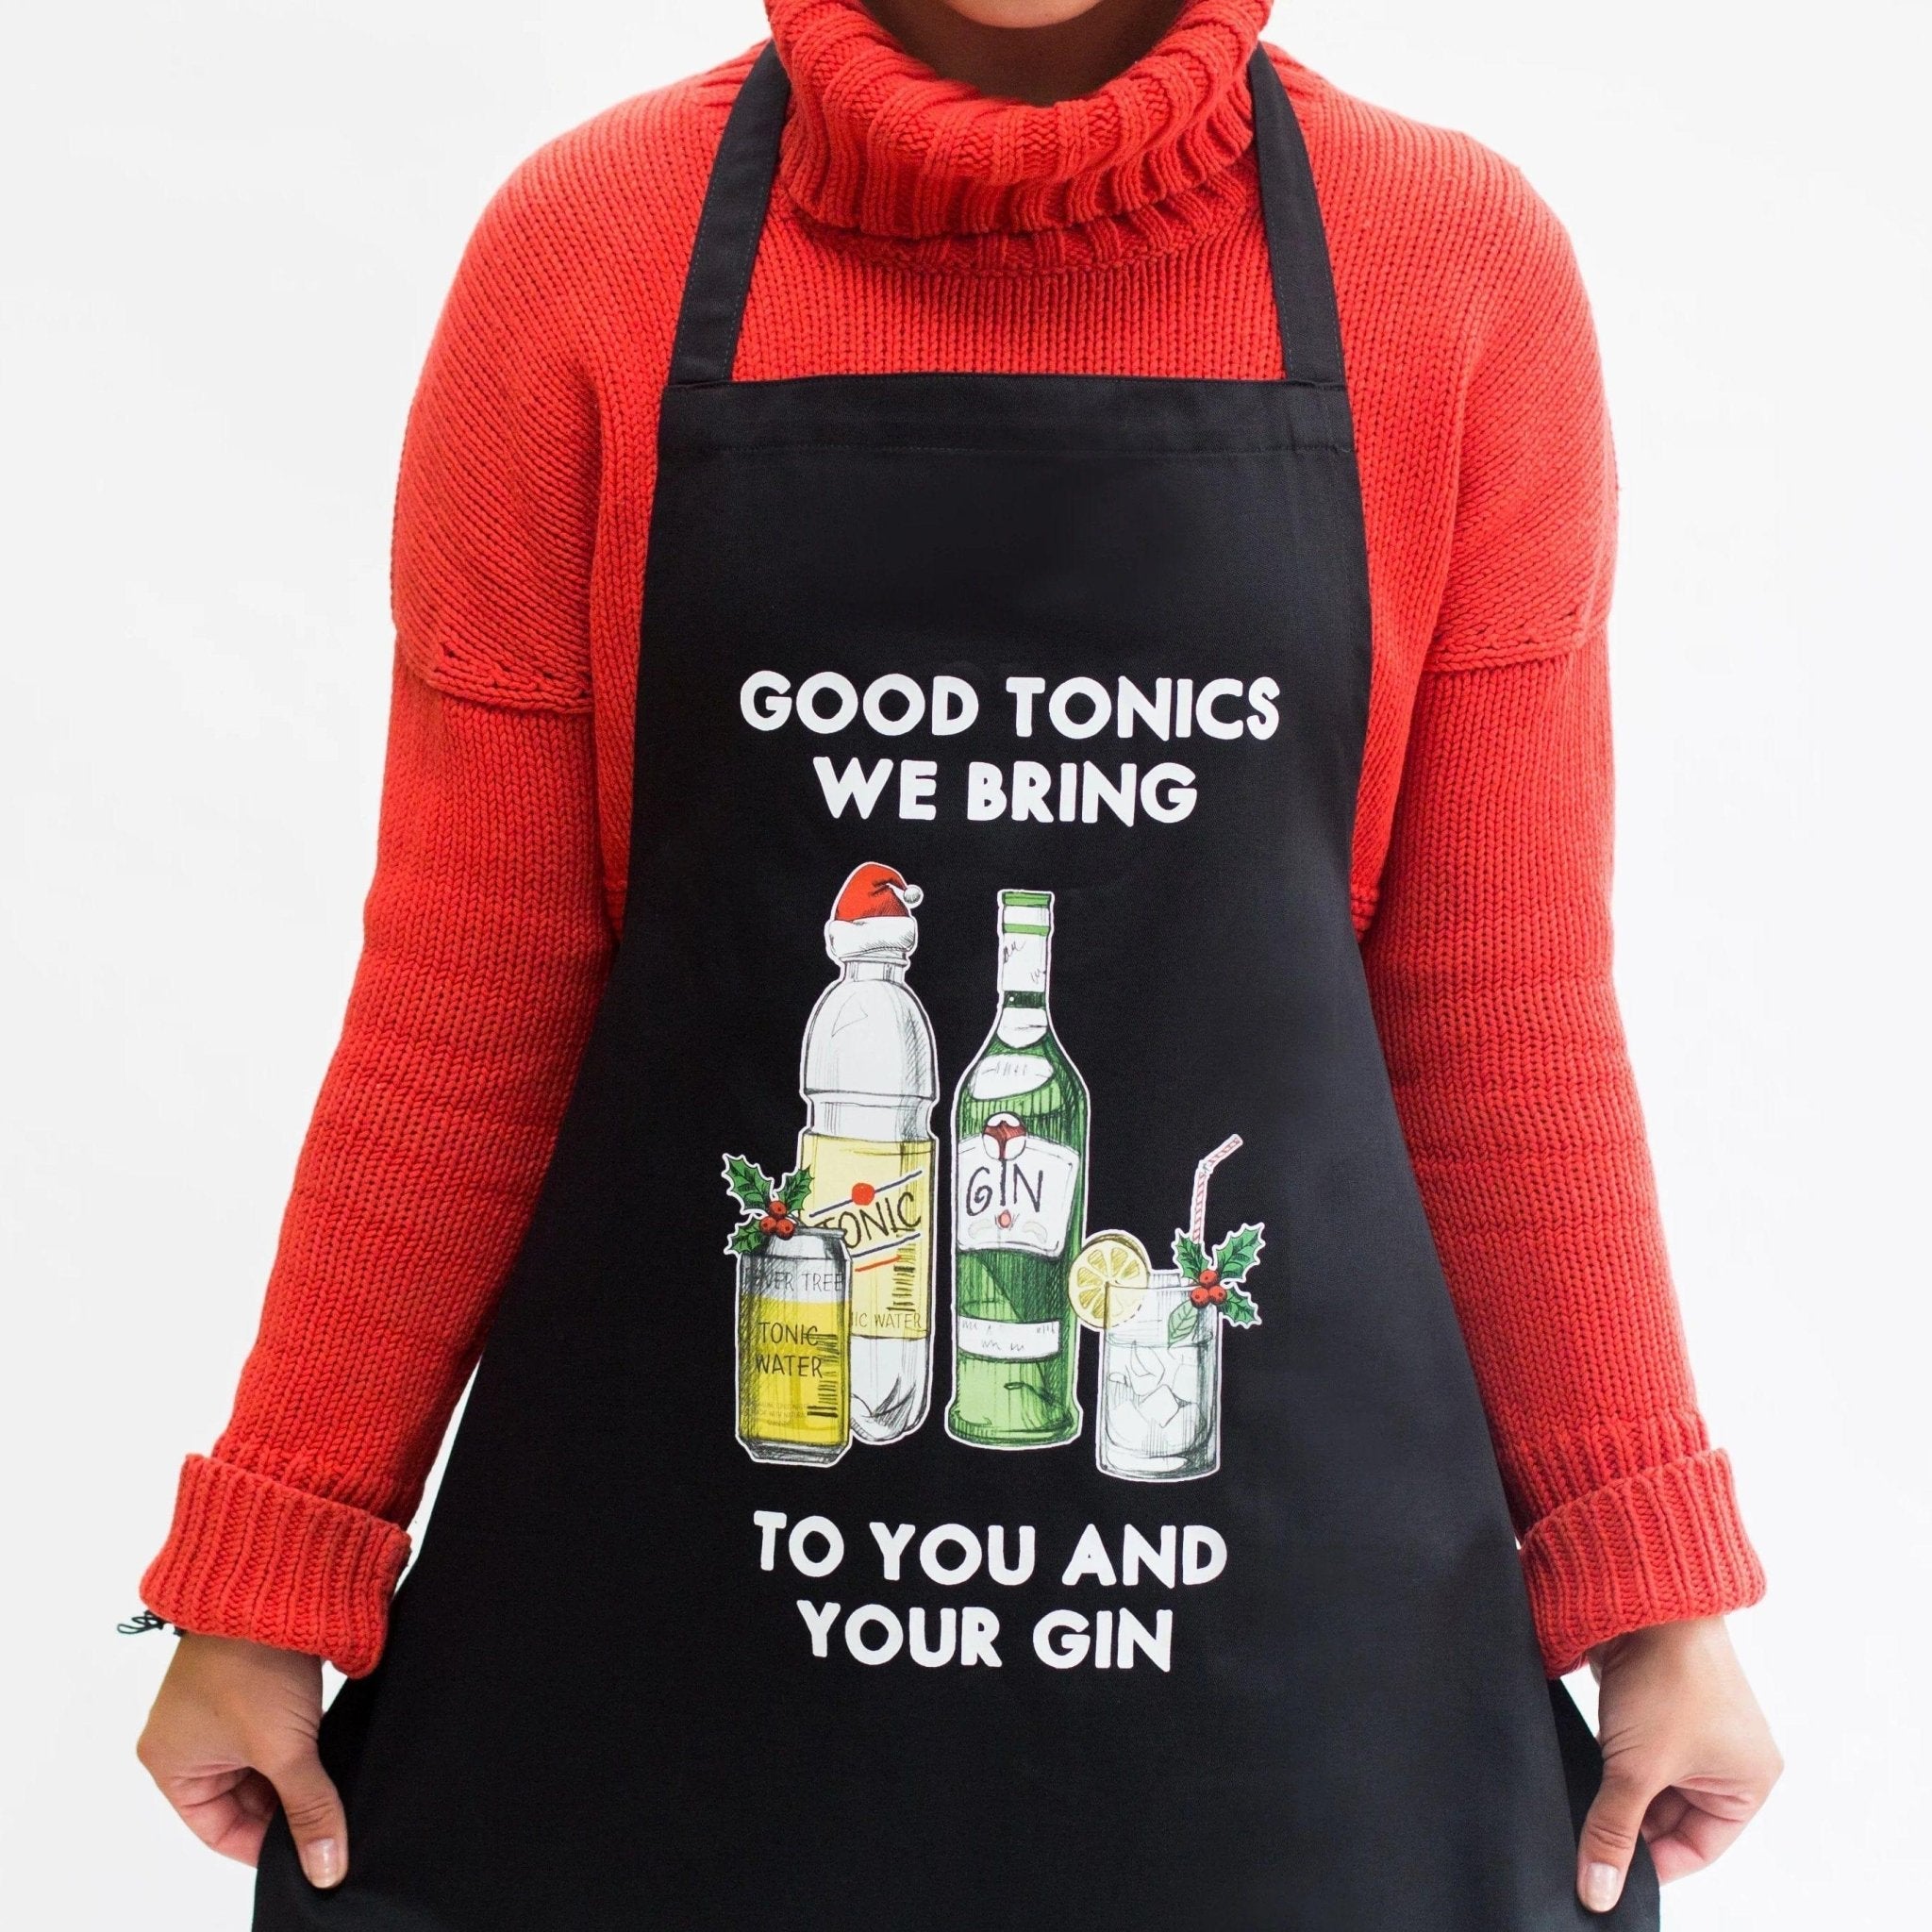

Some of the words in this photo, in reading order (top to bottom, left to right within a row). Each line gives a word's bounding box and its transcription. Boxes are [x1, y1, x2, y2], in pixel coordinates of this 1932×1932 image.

[741, 671, 978, 736] GOOD
[1007, 676, 1280, 741] TONICS
[813, 757, 937, 820] WE
[967, 761, 1197, 826] BRING
[966, 1159, 1043, 1216] GIN
[801, 1272, 842, 1291] TREE
[758, 1322, 819, 1346] TONIC
[874, 1312, 921, 1329] WATER
[756, 1355, 823, 1378] WATER
[754, 1510, 844, 1577] TO
[870, 1523, 1035, 1585] YOU
[1062, 1524, 1227, 1589] AND
[797, 1600, 1002, 1667] YOUR
[1033, 1607, 1173, 1672] GIN
